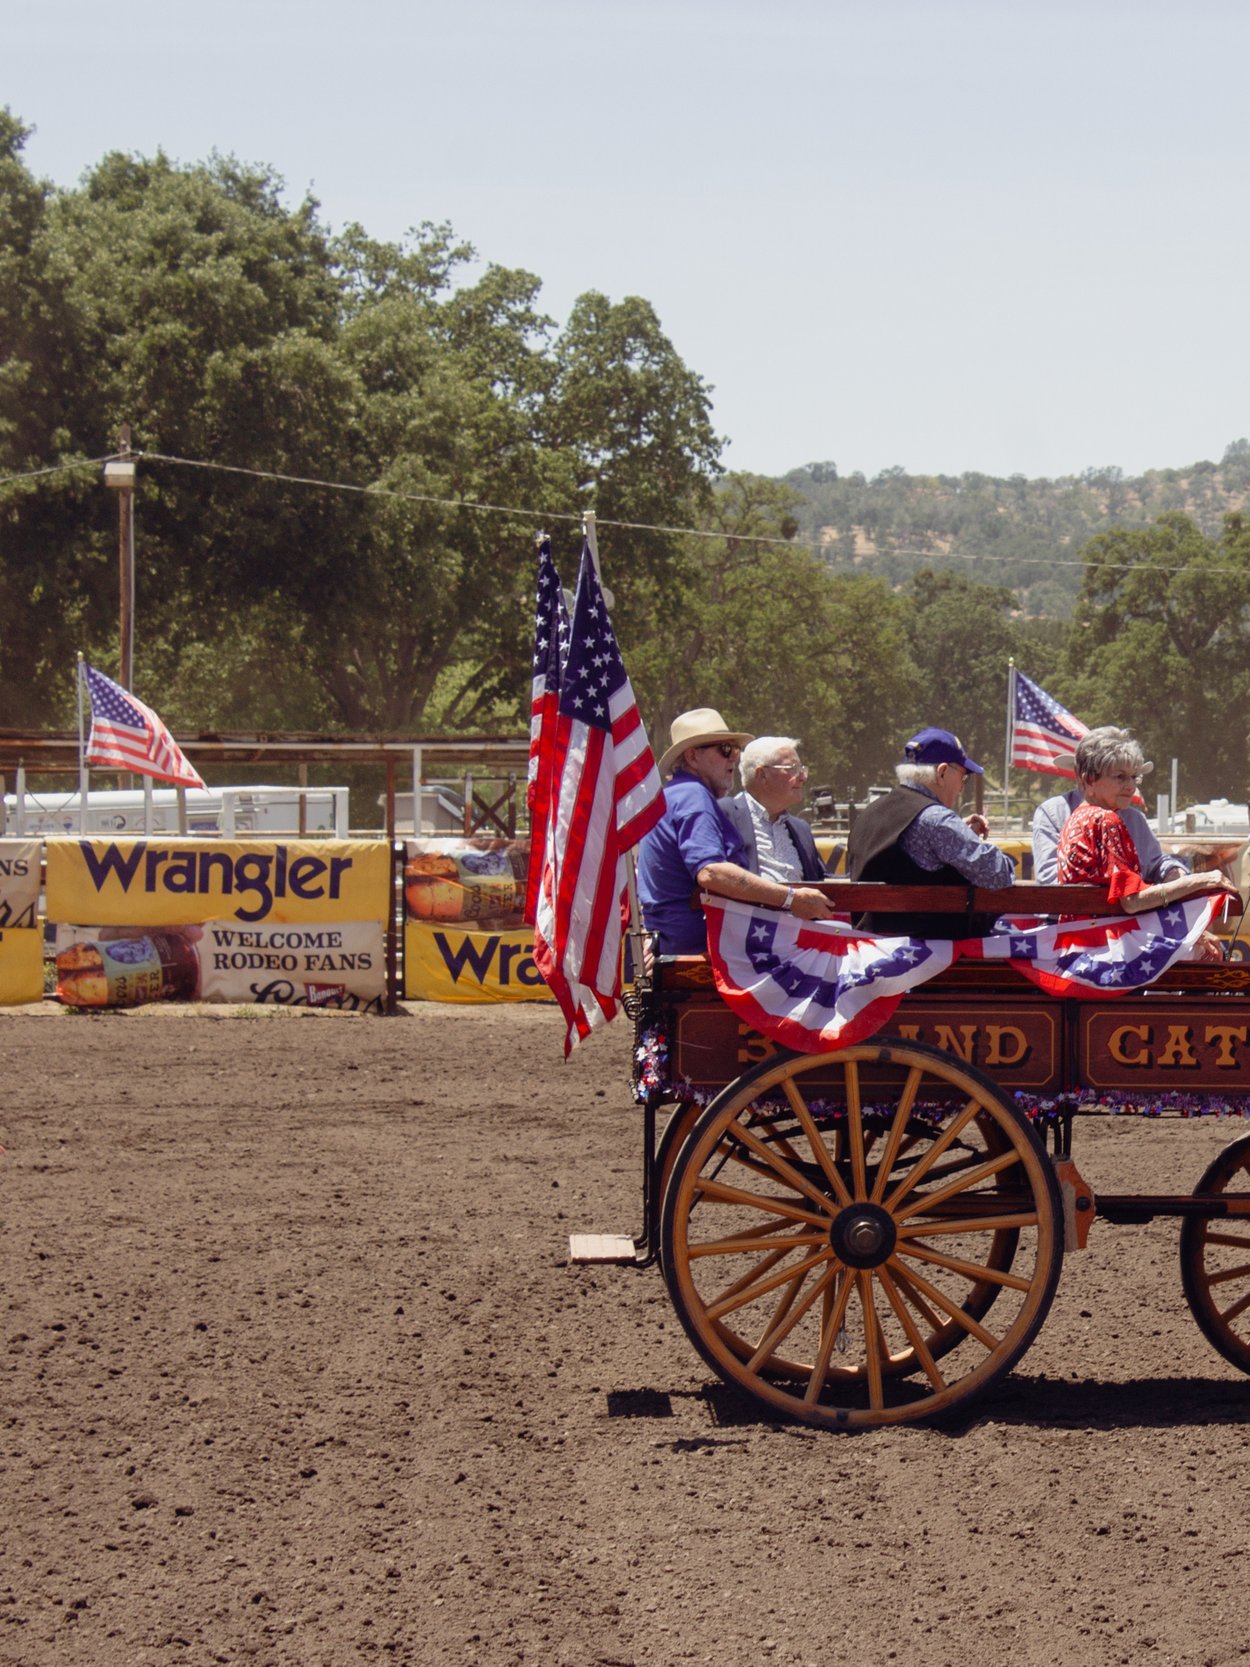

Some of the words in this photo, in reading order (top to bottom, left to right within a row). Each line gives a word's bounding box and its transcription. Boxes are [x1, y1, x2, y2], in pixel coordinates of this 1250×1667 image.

[78, 840, 353, 922] Wrangler
[212, 930, 342, 949] WELCOME
[213, 952, 298, 971] RODEO
[304, 953, 372, 971] FANS
